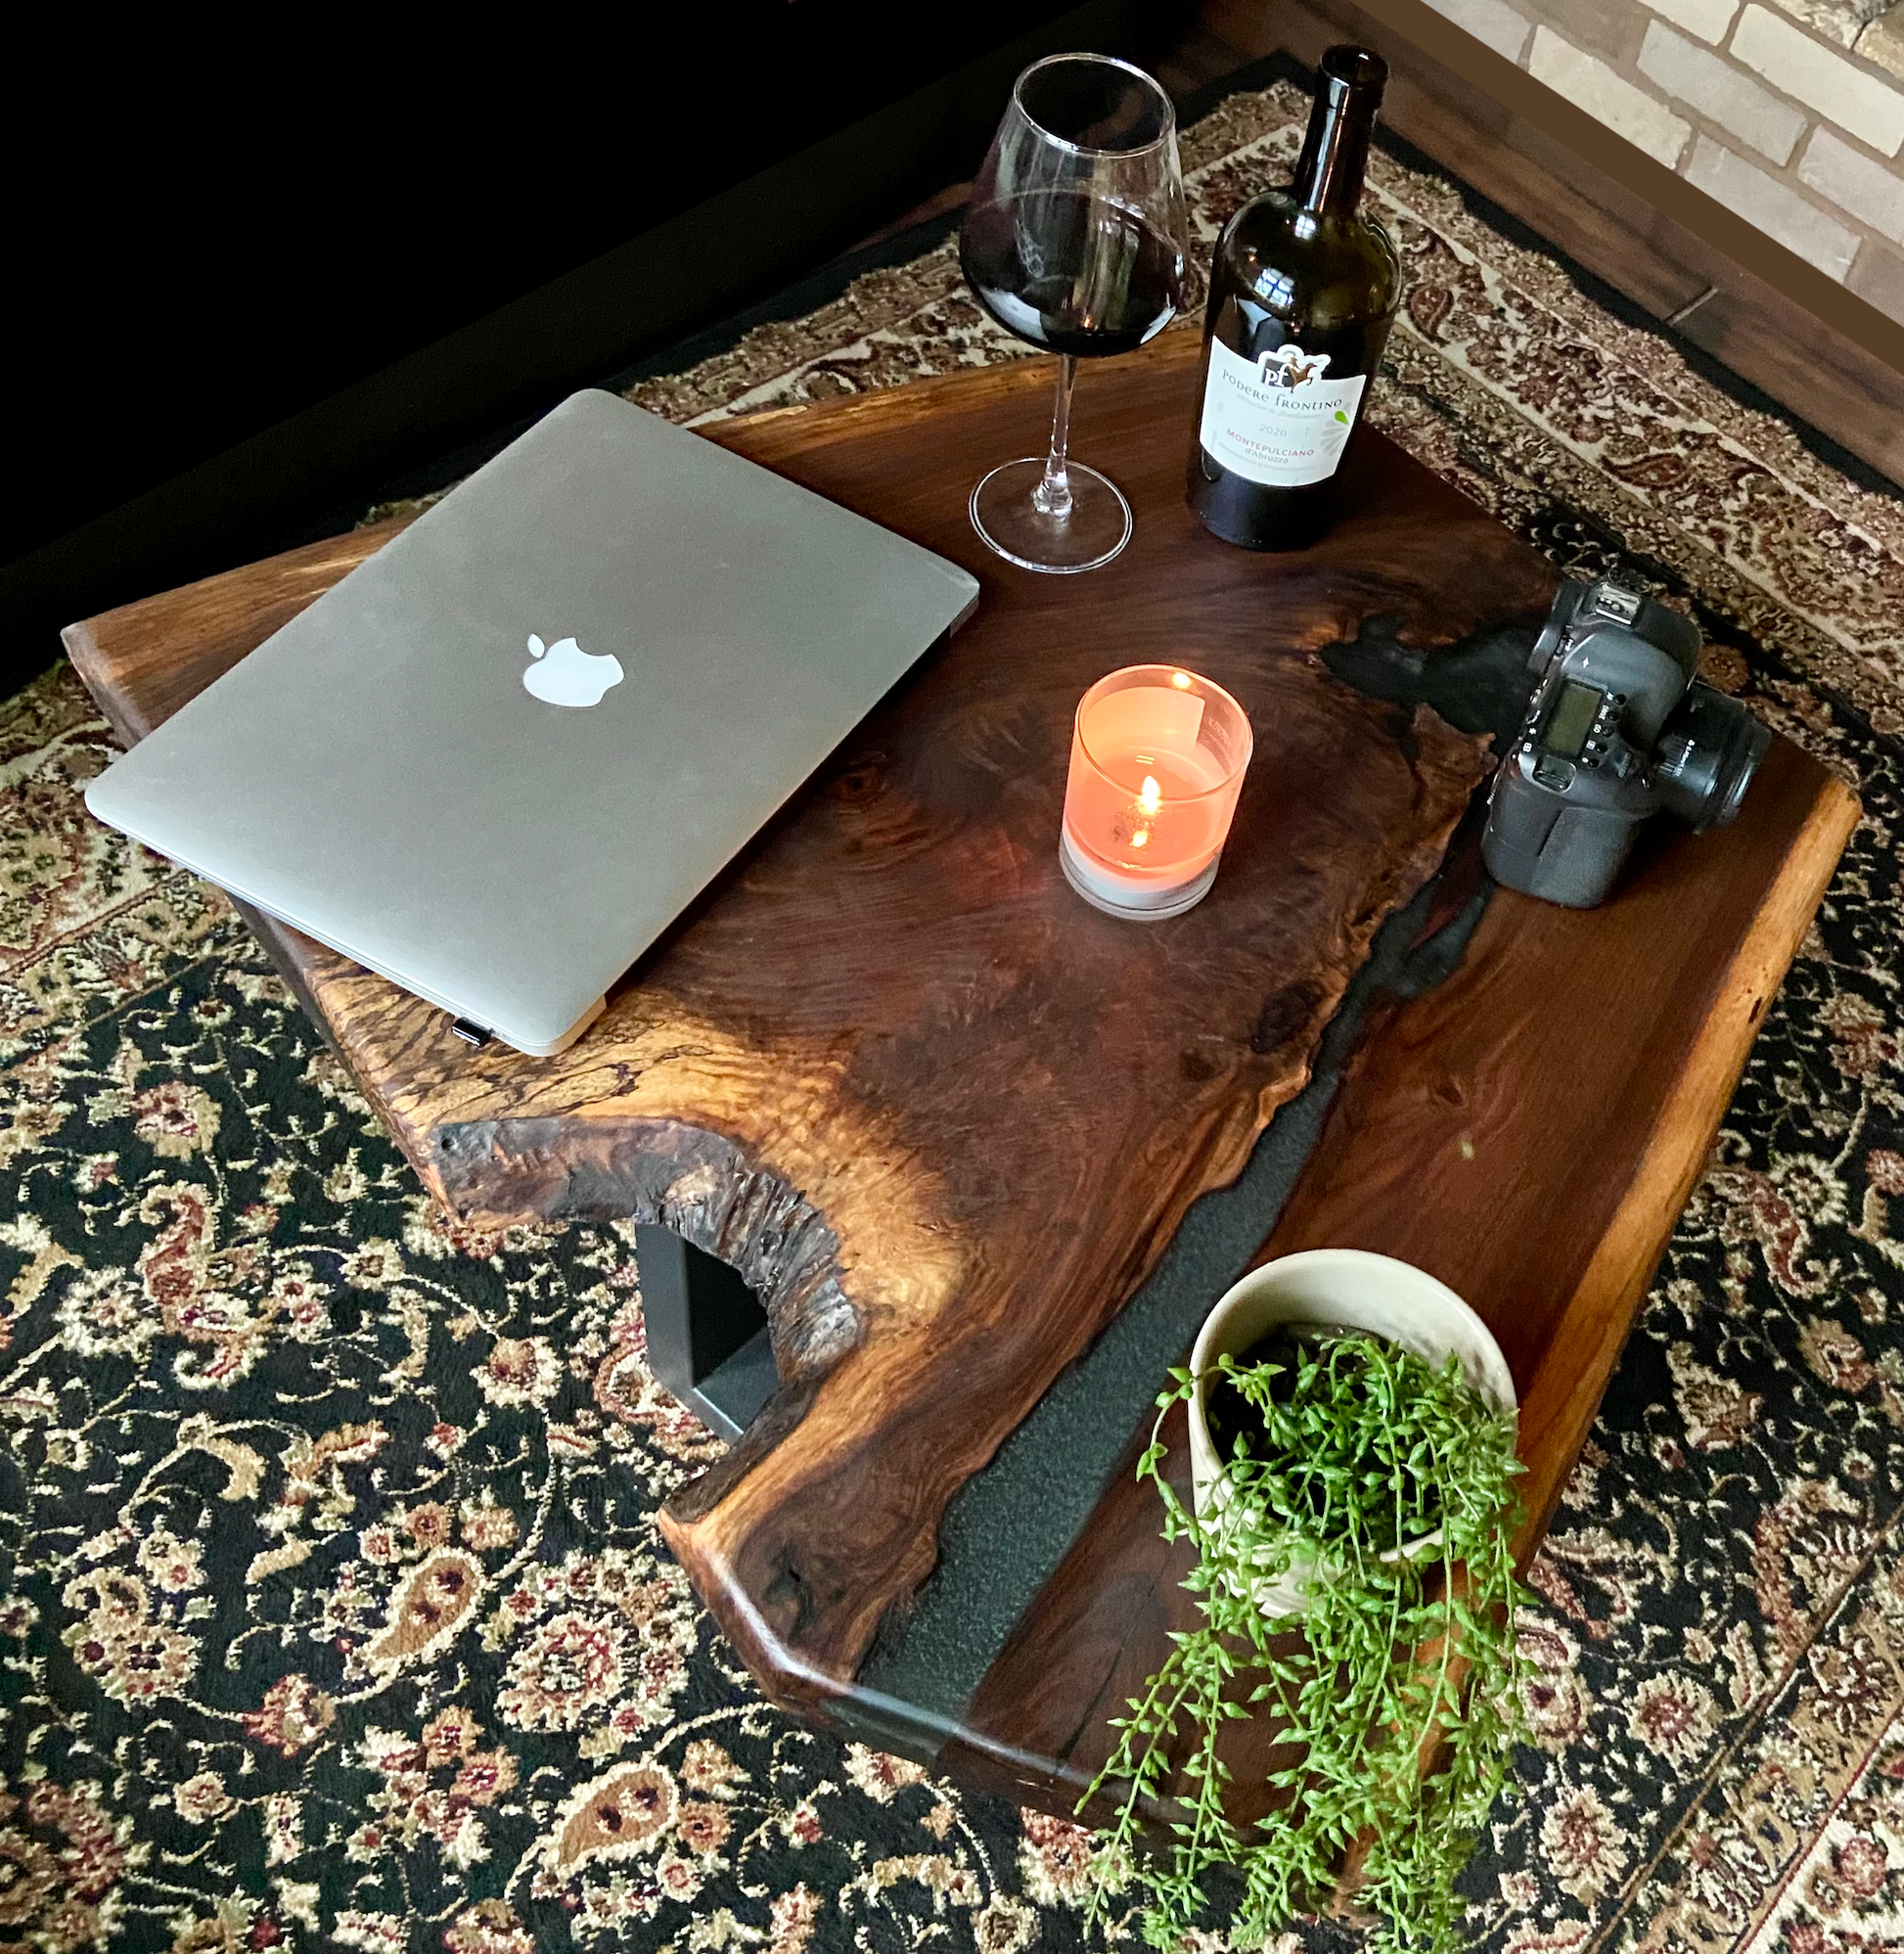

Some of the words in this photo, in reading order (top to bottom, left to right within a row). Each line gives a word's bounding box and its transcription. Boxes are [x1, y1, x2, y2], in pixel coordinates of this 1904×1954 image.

[1259, 424, 1288, 437] 2020
[1226, 428, 1314, 457] MONTEPULCIANO
[1245, 447, 1289, 464] d'Abruzzo
